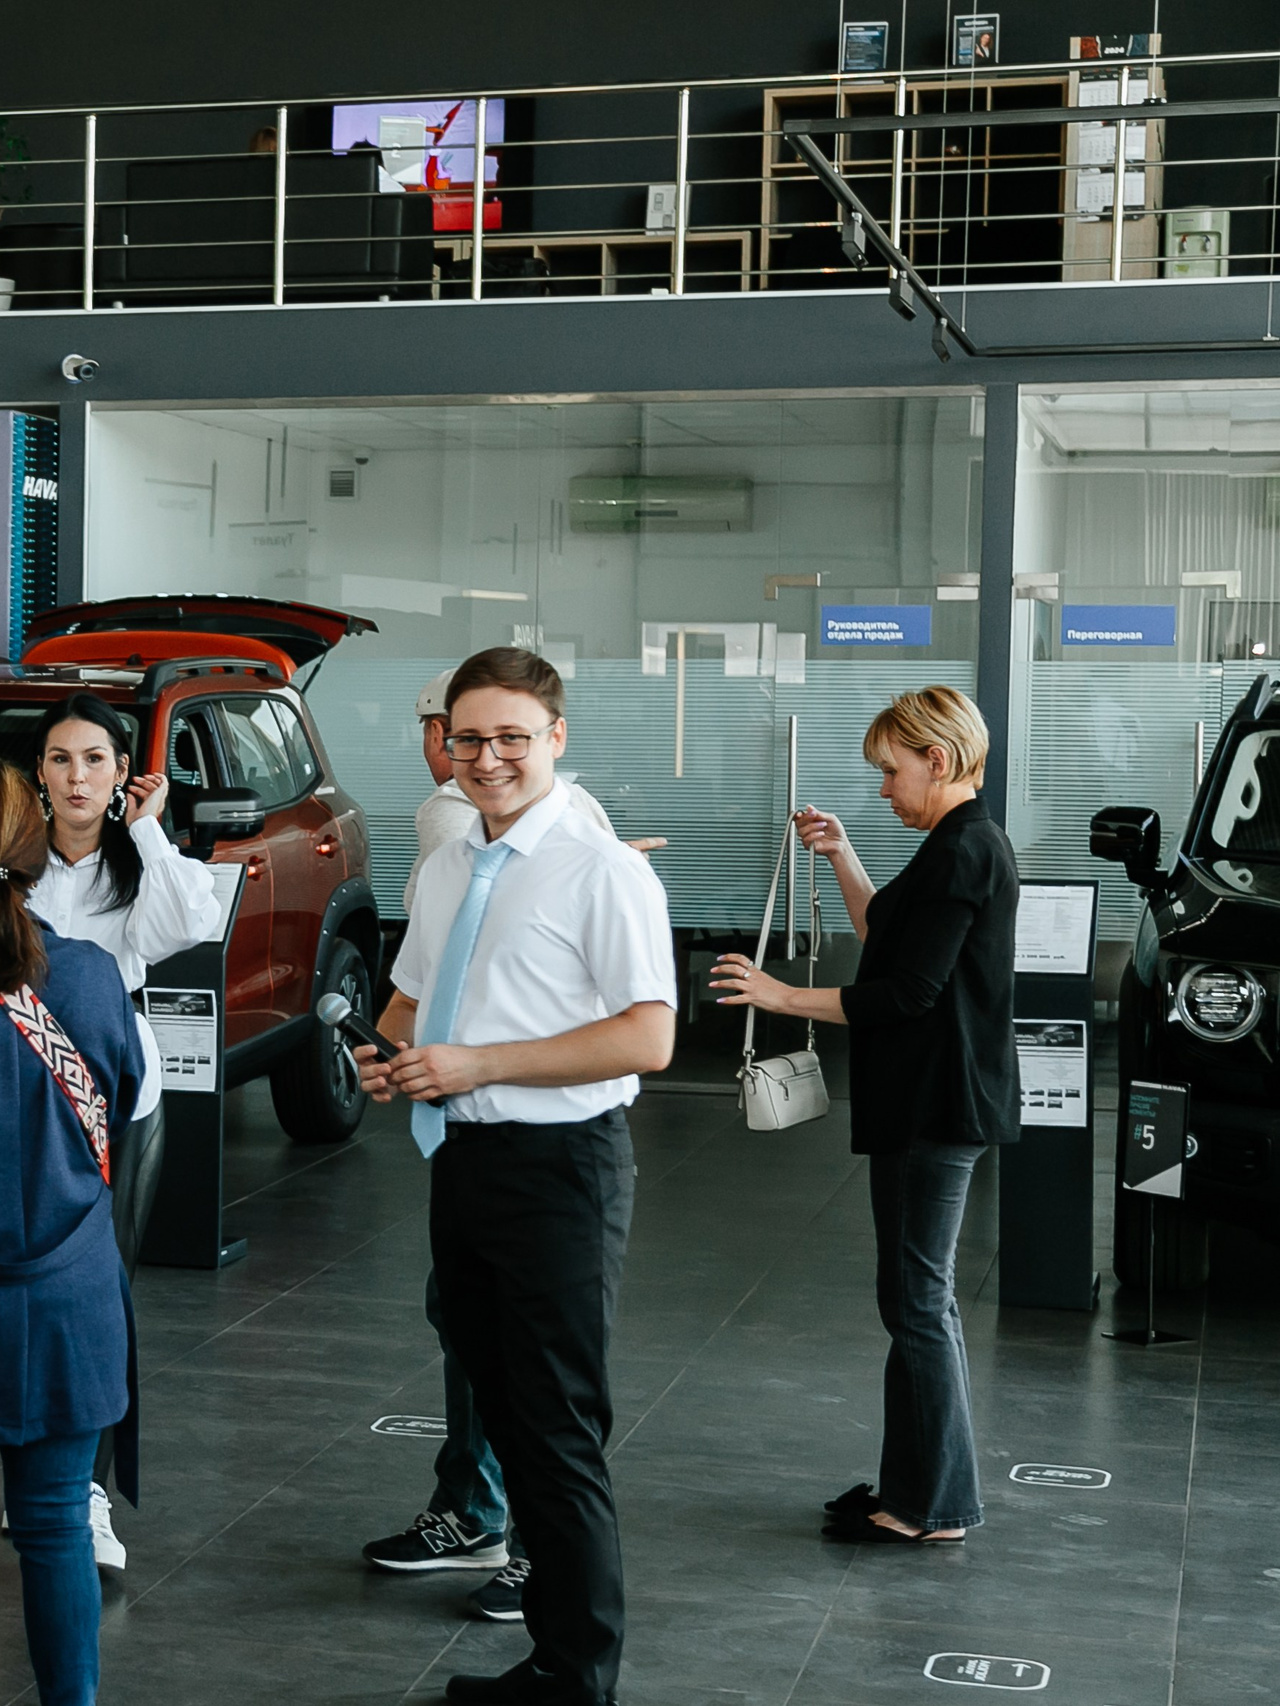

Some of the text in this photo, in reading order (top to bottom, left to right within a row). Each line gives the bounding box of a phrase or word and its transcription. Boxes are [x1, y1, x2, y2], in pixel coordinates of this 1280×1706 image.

[827, 619, 900, 632] Руководитель
[827, 631, 904, 641] отдела продаж
[1067, 629, 1143, 642] Переговорная
[1133, 1124, 1155, 1150] #5
[421, 1523, 459, 1553] N
